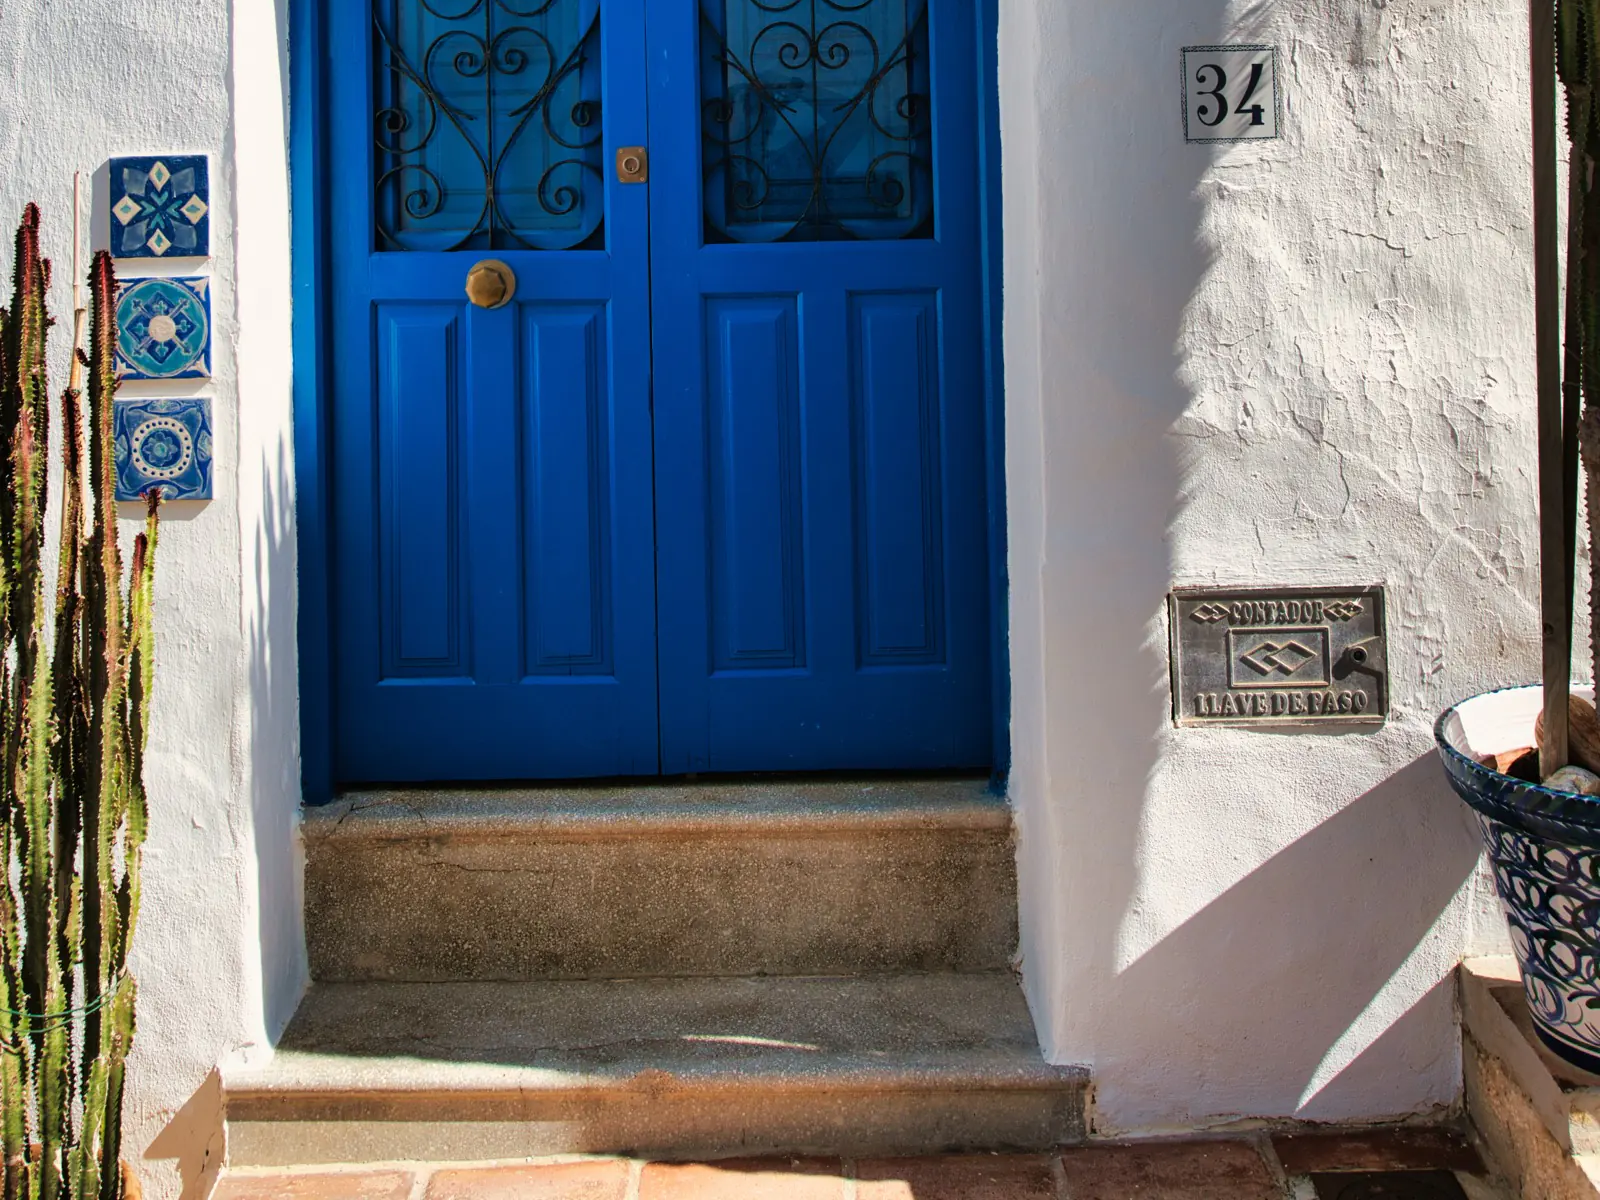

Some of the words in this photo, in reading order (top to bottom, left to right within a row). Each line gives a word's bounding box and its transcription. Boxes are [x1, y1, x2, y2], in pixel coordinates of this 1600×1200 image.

[1195, 63, 1265, 127] 34
[1229, 600, 1325, 626] CONTADOR
[1195, 692, 1268, 717] LLAVE
[1307, 689, 1369, 715] PASO
